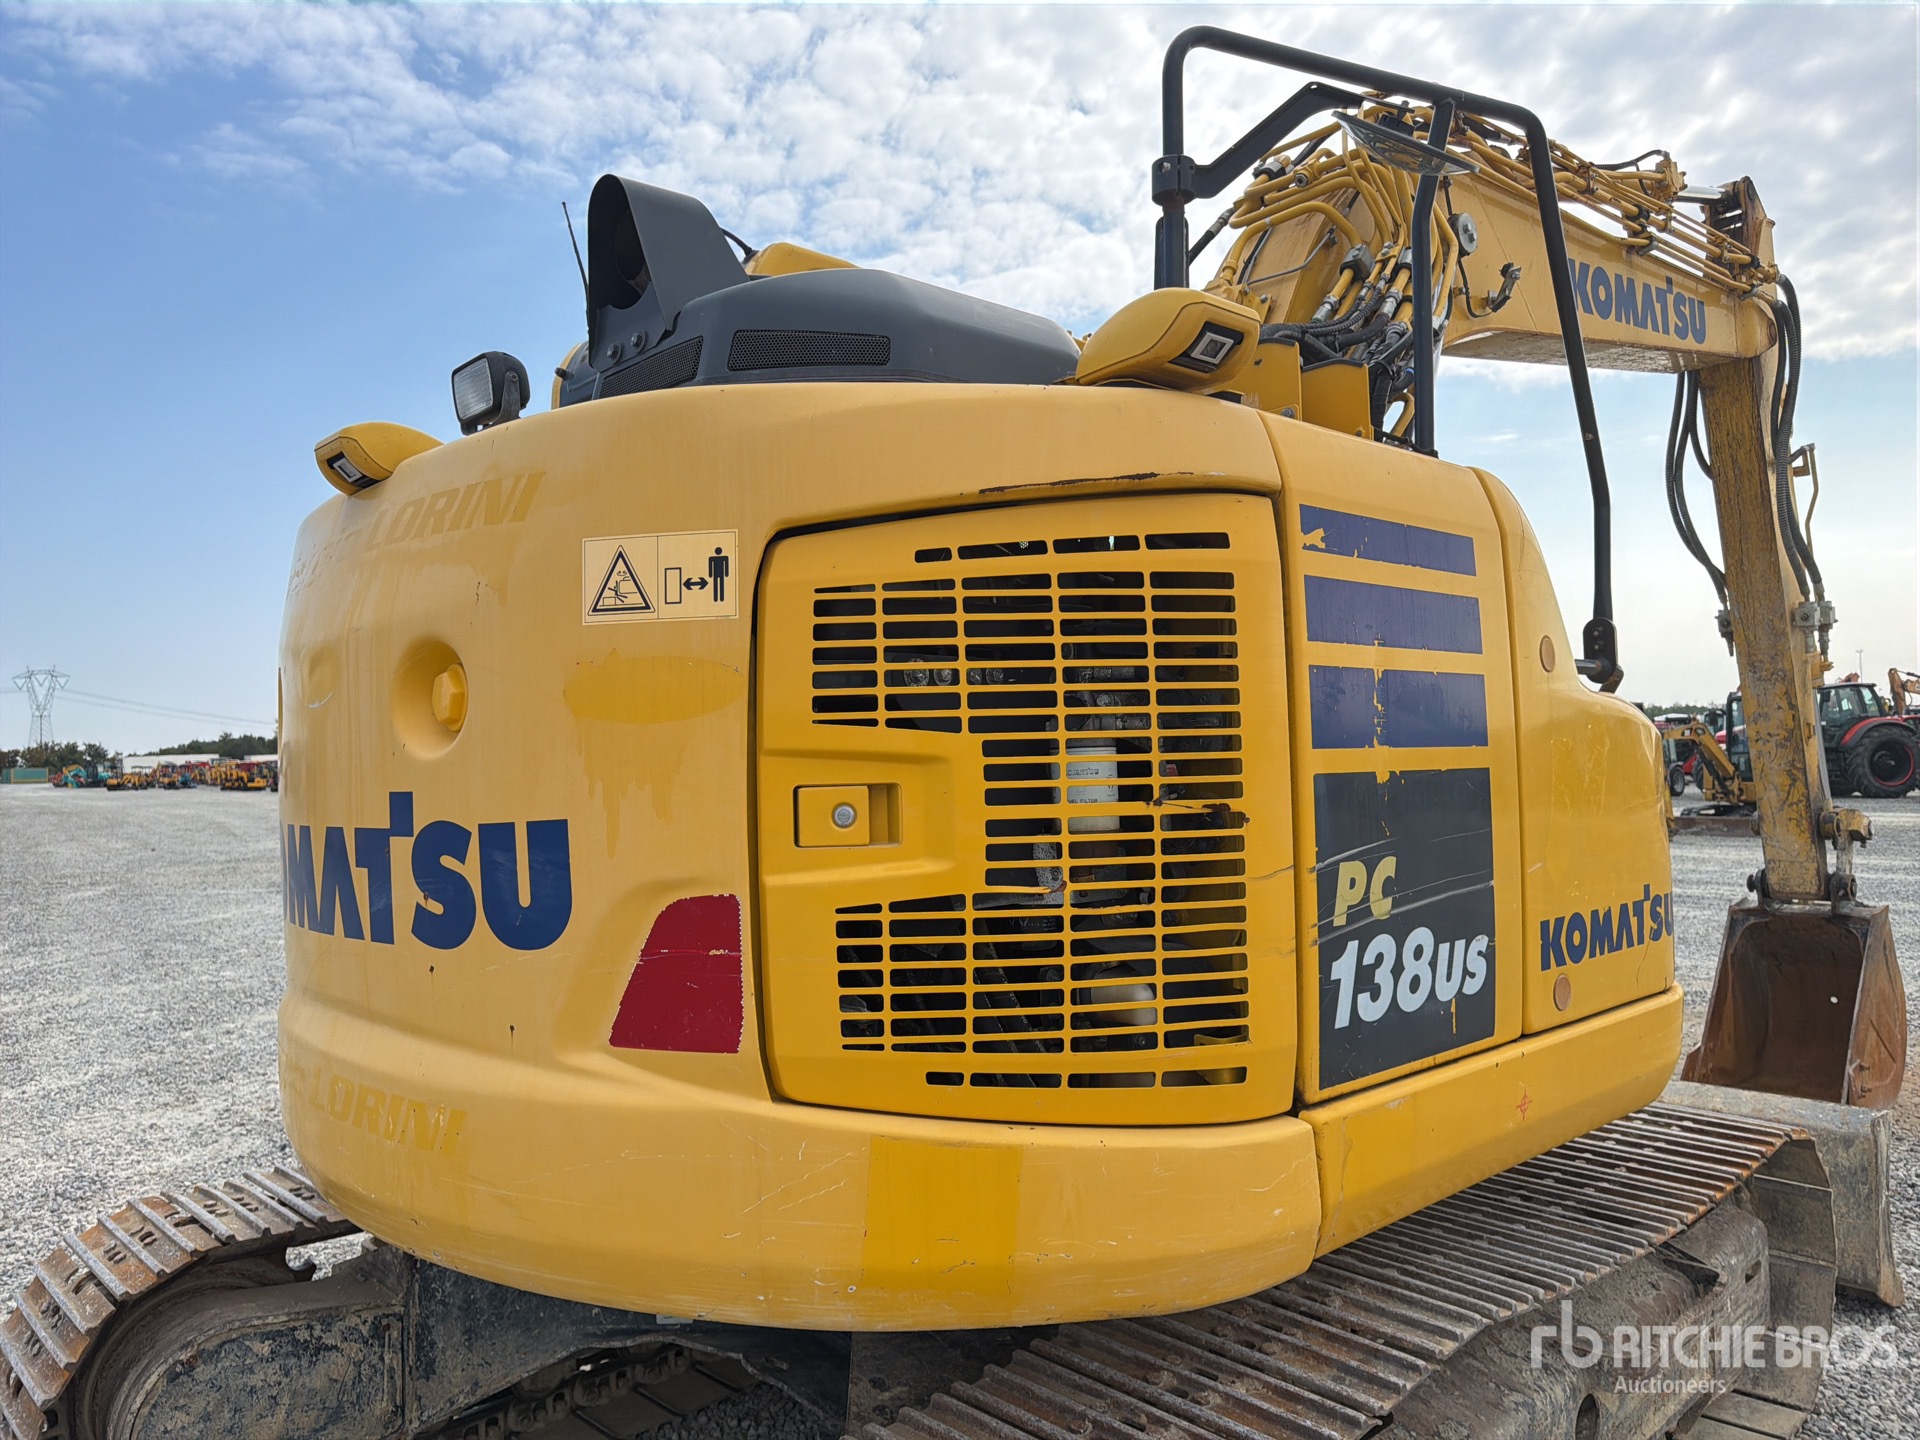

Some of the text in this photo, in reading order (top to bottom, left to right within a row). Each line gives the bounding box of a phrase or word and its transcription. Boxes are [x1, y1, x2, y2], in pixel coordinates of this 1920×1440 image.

[1569, 258, 1706, 345] KOMATSU
[1333, 855, 1398, 928] PC
[1540, 884, 1674, 971] KOMATSU
